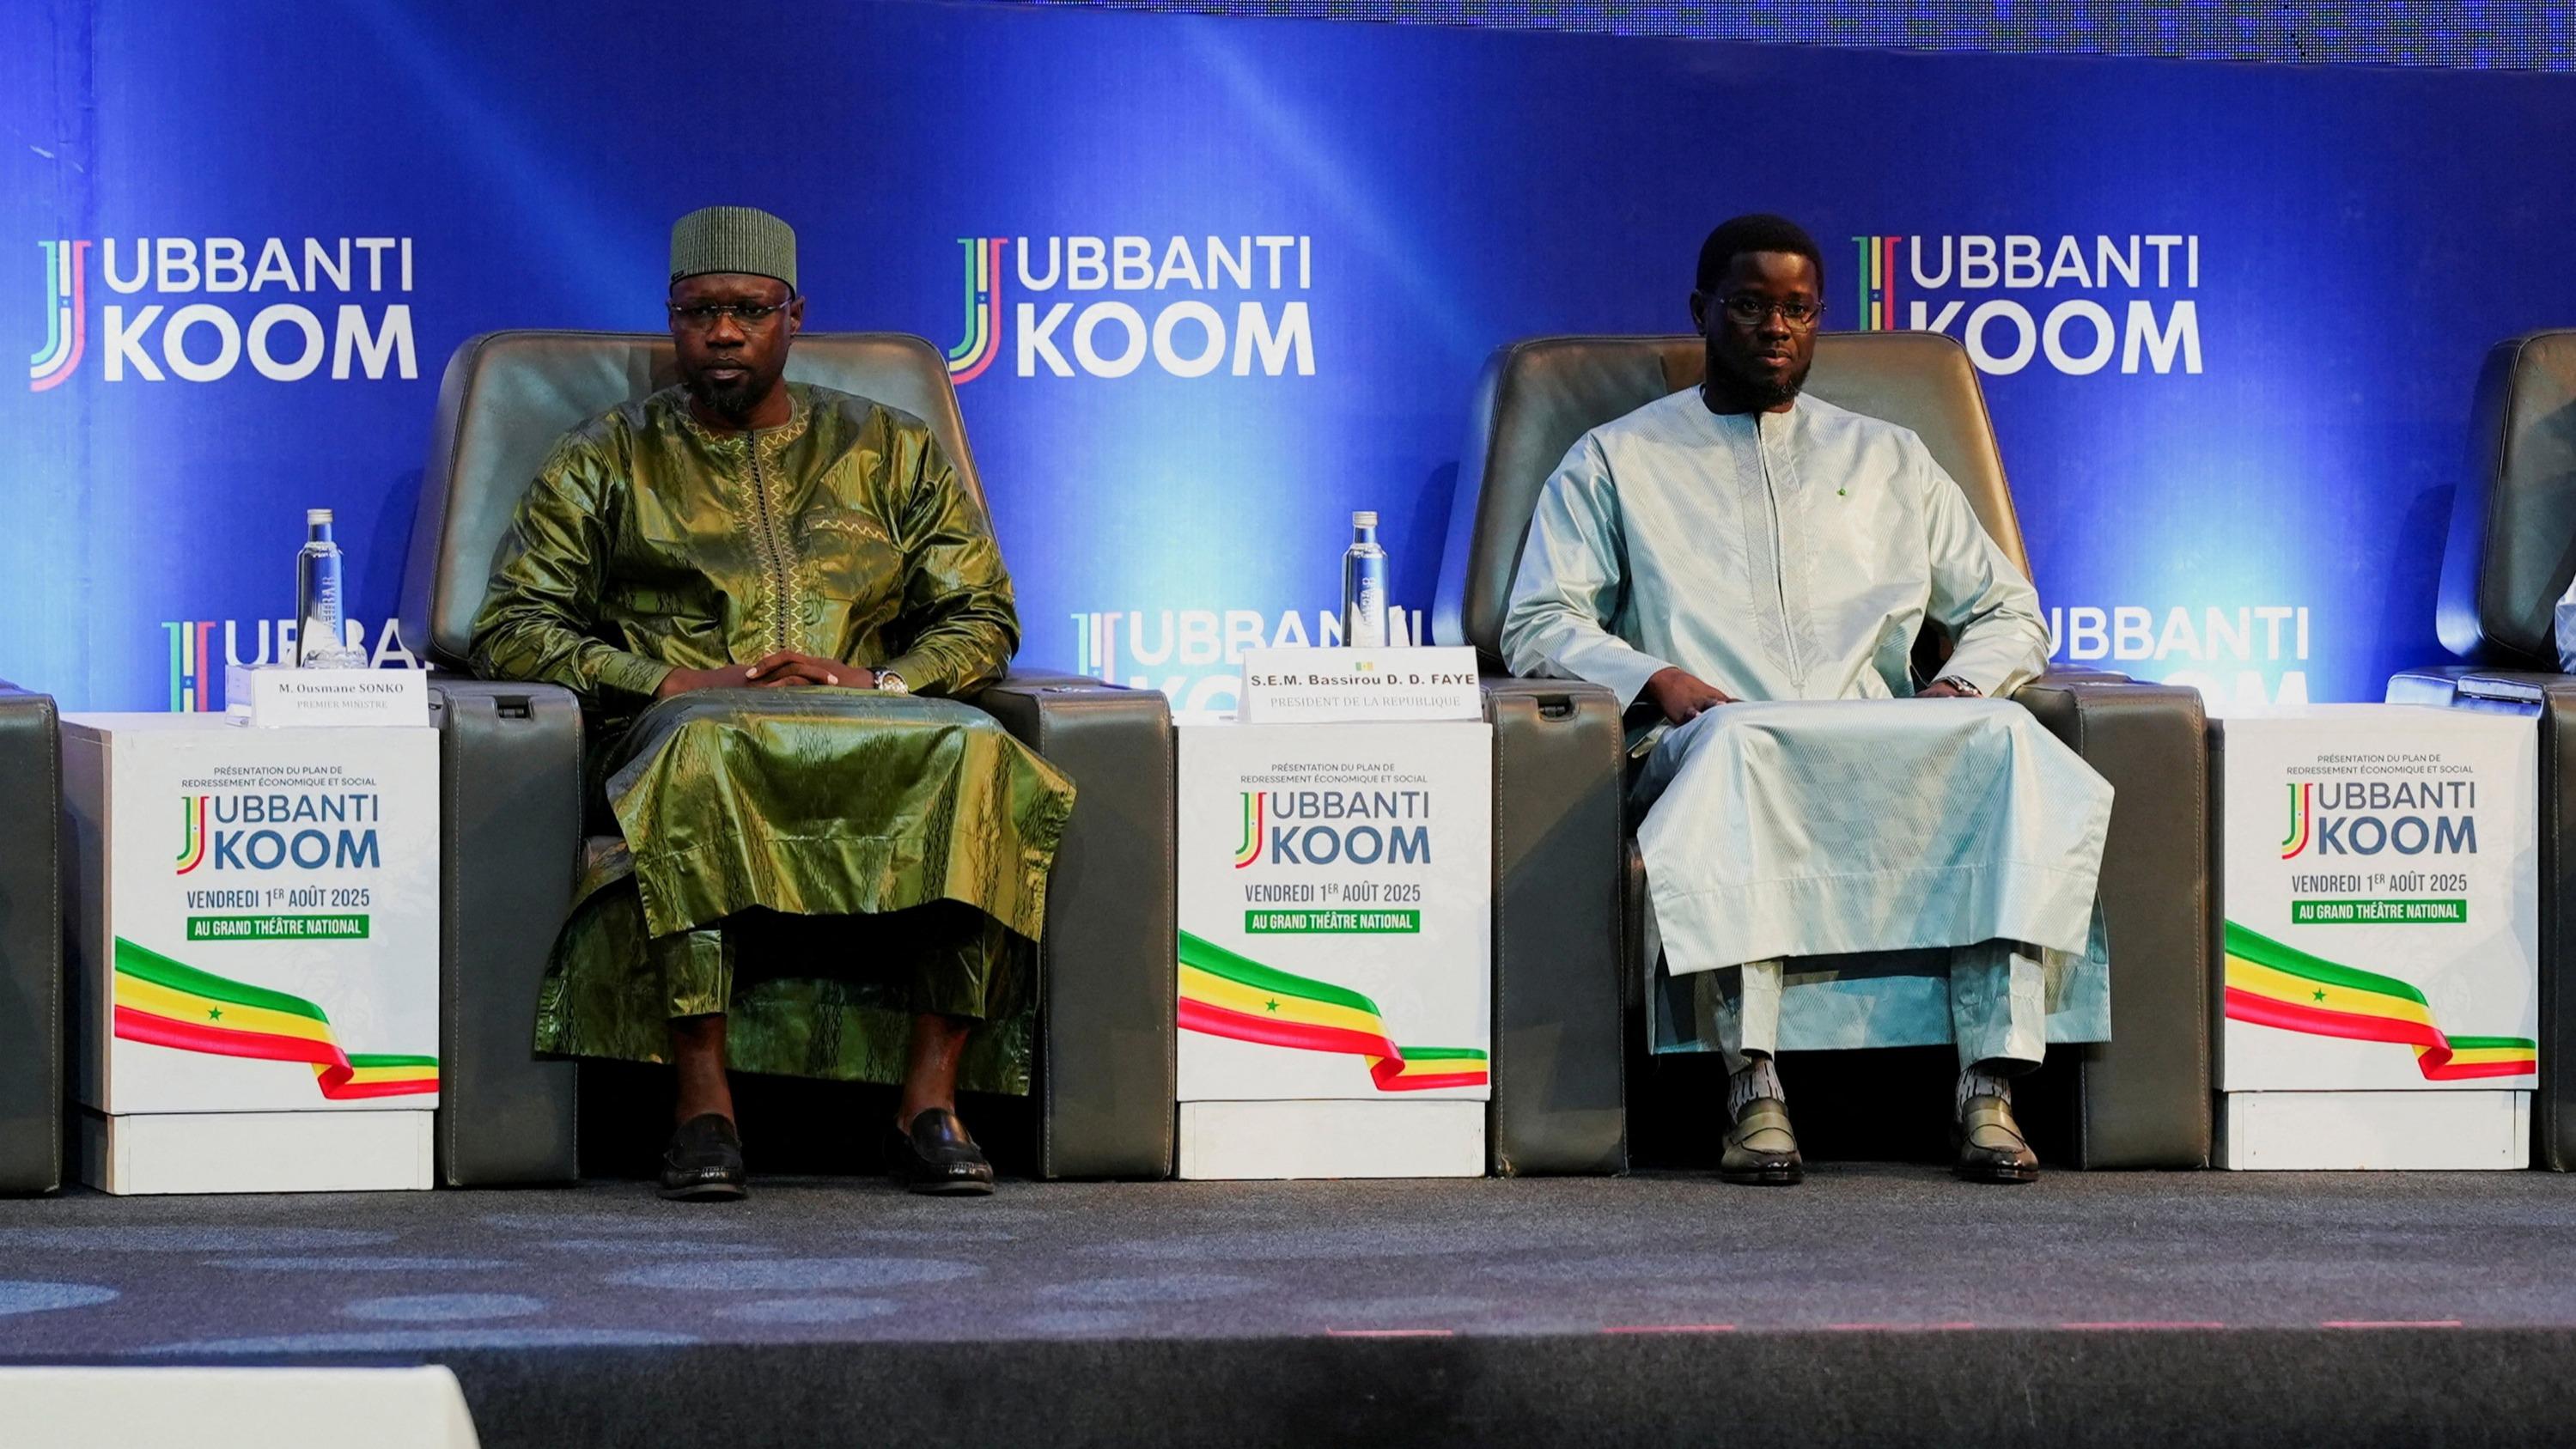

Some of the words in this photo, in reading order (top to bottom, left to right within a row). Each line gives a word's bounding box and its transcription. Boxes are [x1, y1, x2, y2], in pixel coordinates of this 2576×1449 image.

[103, 303, 418, 382] KOOM
[1017, 301, 1316, 378] KOOM
[278, 684, 293, 693] M.
[297, 684, 356, 693] Ousmane
[359, 683, 404, 693] SONKO
[1251, 675, 1303, 686] S.E.M.
[1309, 674, 1381, 685] Bassirou
[1387, 673, 1403, 685] D.
[1410, 673, 1425, 685] D.
[1432, 673, 1476, 685] FAYE
[297, 700, 339, 709] PREMIER
[342, 700, 387, 709] MINISTRE
[1343, 697, 1360, 707] DE
[1363, 696, 1379, 707] LA
[1271, 763, 1338, 771] PRÉSENTATION
[2317, 754, 2384, 764] PRÉSENTATION
[2387, 754, 2400, 763] DU
[214, 765, 283, 775] PRÉSENTATION
[1314, 774, 1379, 783] ÉCONOMIQUE
[2360, 765, 2425, 774] ÉCONOMIQUE
[182, 779, 256, 788] REDRESSEMENT
[259, 777, 326, 787] ÉCONOMIQUE
[342, 777, 377, 786] SOCIAL
[2318, 816, 2477, 855] KOOM
[215, 829, 380, 870] KOOM
[1272, 825, 1431, 865] KOOM
[2292, 874, 2360, 892] VENDREDI
[2389, 870, 2425, 892] AOÛT
[2430, 874, 2467, 892] 2025
[187, 890, 259, 909] VENDREDI
[289, 885, 326, 907] AOÛT
[331, 889, 369, 907] 2025
[1245, 885, 1314, 902] VENDREDI
[1343, 880, 1379, 902] AOÛT
[1384, 884, 1421, 902] 2025
[2299, 905, 2314, 919] AU
[2317, 904, 2354, 919] GRAND
[2356, 901, 2404, 919] THÉÂTRE
[2407, 904, 2459, 918] NATIONAL
[194, 921, 210, 936] AU
[213, 920, 251, 935] GRAND
[254, 916, 304, 935] THÉÂTRE
[306, 919, 362, 935] NATIONAL
[1251, 915, 1267, 929] AU
[1270, 915, 1306, 928] GRAND
[1309, 910, 1357, 928] THÉÂTRE
[1360, 914, 1413, 928] NATIONAL
